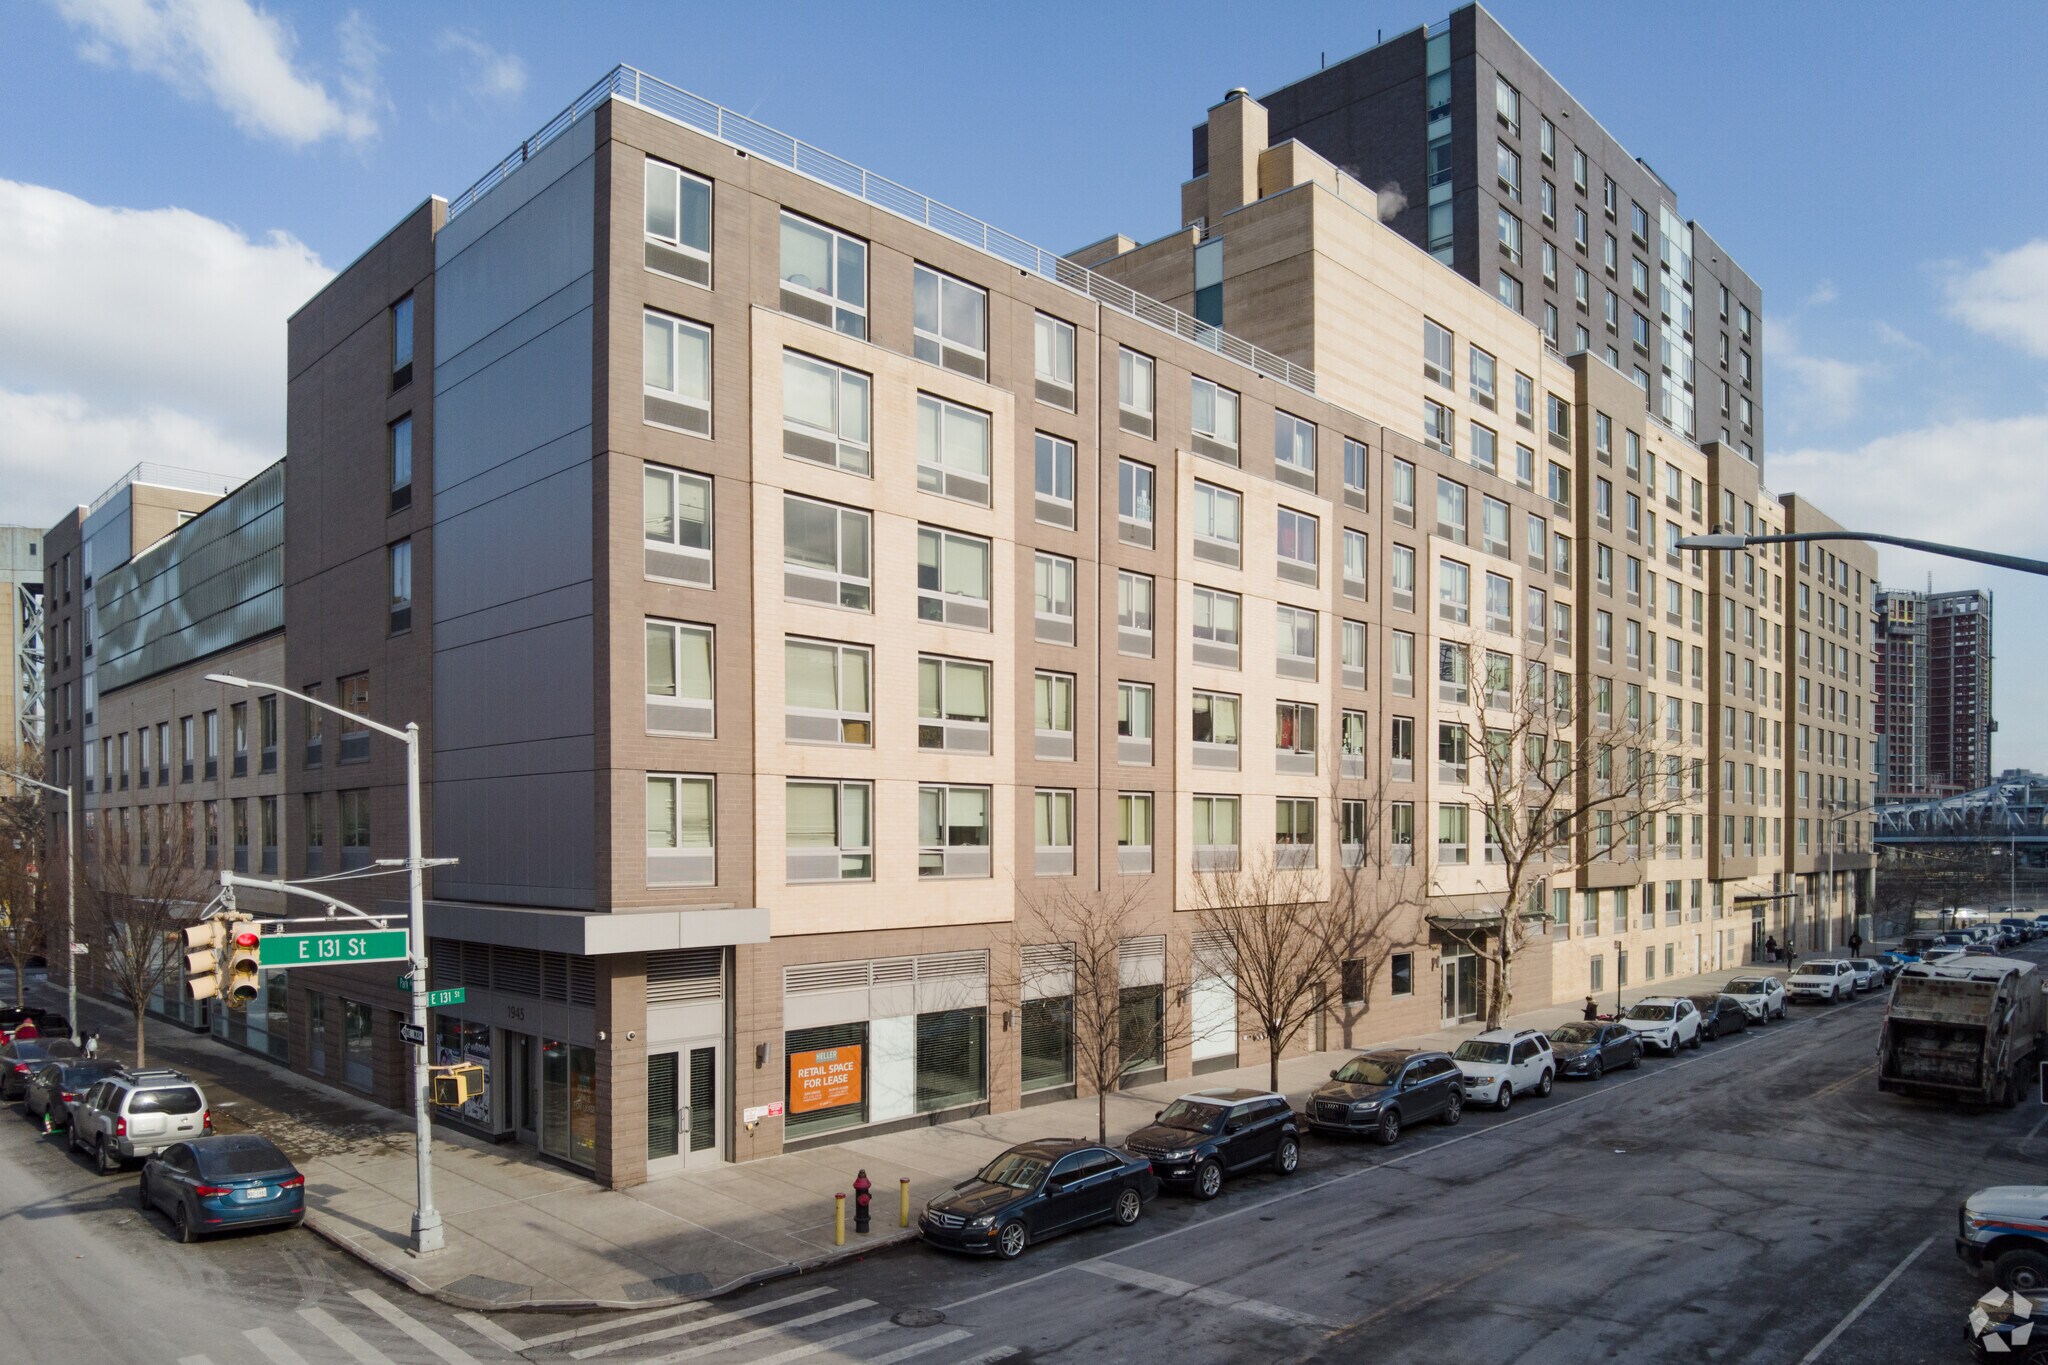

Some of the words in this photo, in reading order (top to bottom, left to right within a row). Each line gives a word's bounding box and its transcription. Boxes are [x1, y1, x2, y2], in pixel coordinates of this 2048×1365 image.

[299, 940, 310, 959] E
[317, 938, 340, 958] 131
[348, 937, 367, 956] St
[431, 993, 437, 1005] E
[440, 991, 452, 1004] 131
[454, 990, 461, 998] St
[507, 1005, 525, 1021] 1945
[816, 1050, 838, 1061] HELLER
[798, 1066, 827, 1078] RETAIL
[828, 1061, 854, 1074] SPACE
[804, 1078, 821, 1089] FOR
[823, 1074, 848, 1086] LEASE
